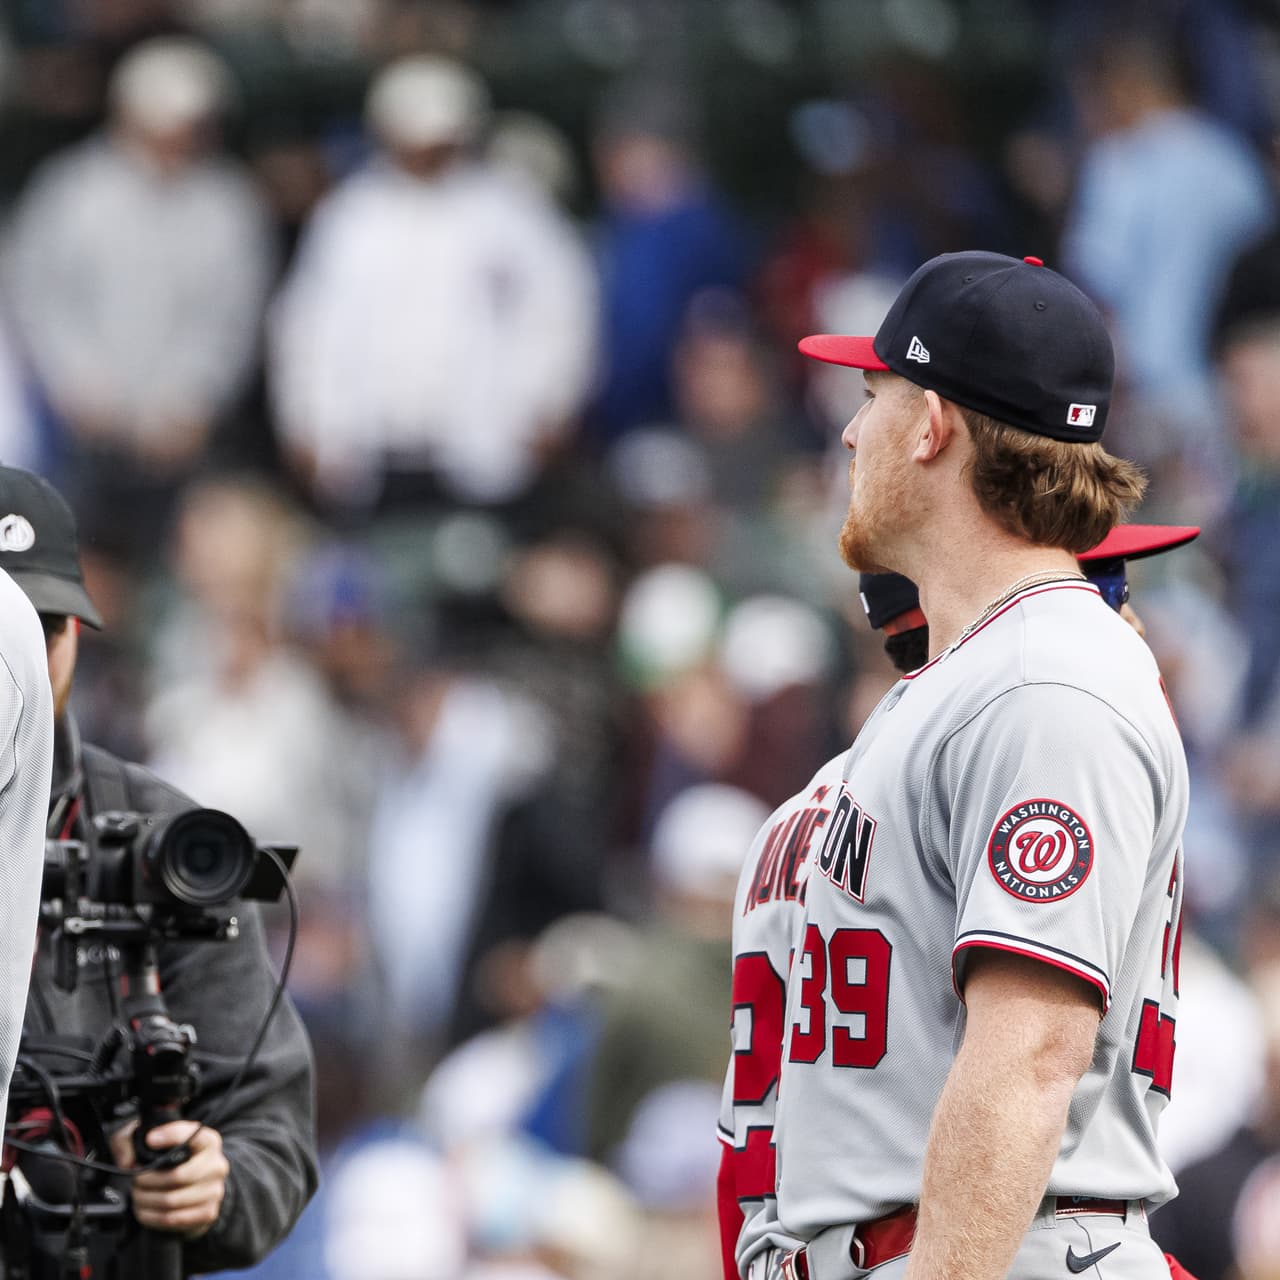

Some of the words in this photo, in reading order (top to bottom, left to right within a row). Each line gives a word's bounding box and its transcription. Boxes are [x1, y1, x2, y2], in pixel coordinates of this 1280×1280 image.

[999, 803, 1090, 849] WASHINGTON
[995, 861, 1078, 898] NATIONALS
[788, 922, 892, 1070] 39
